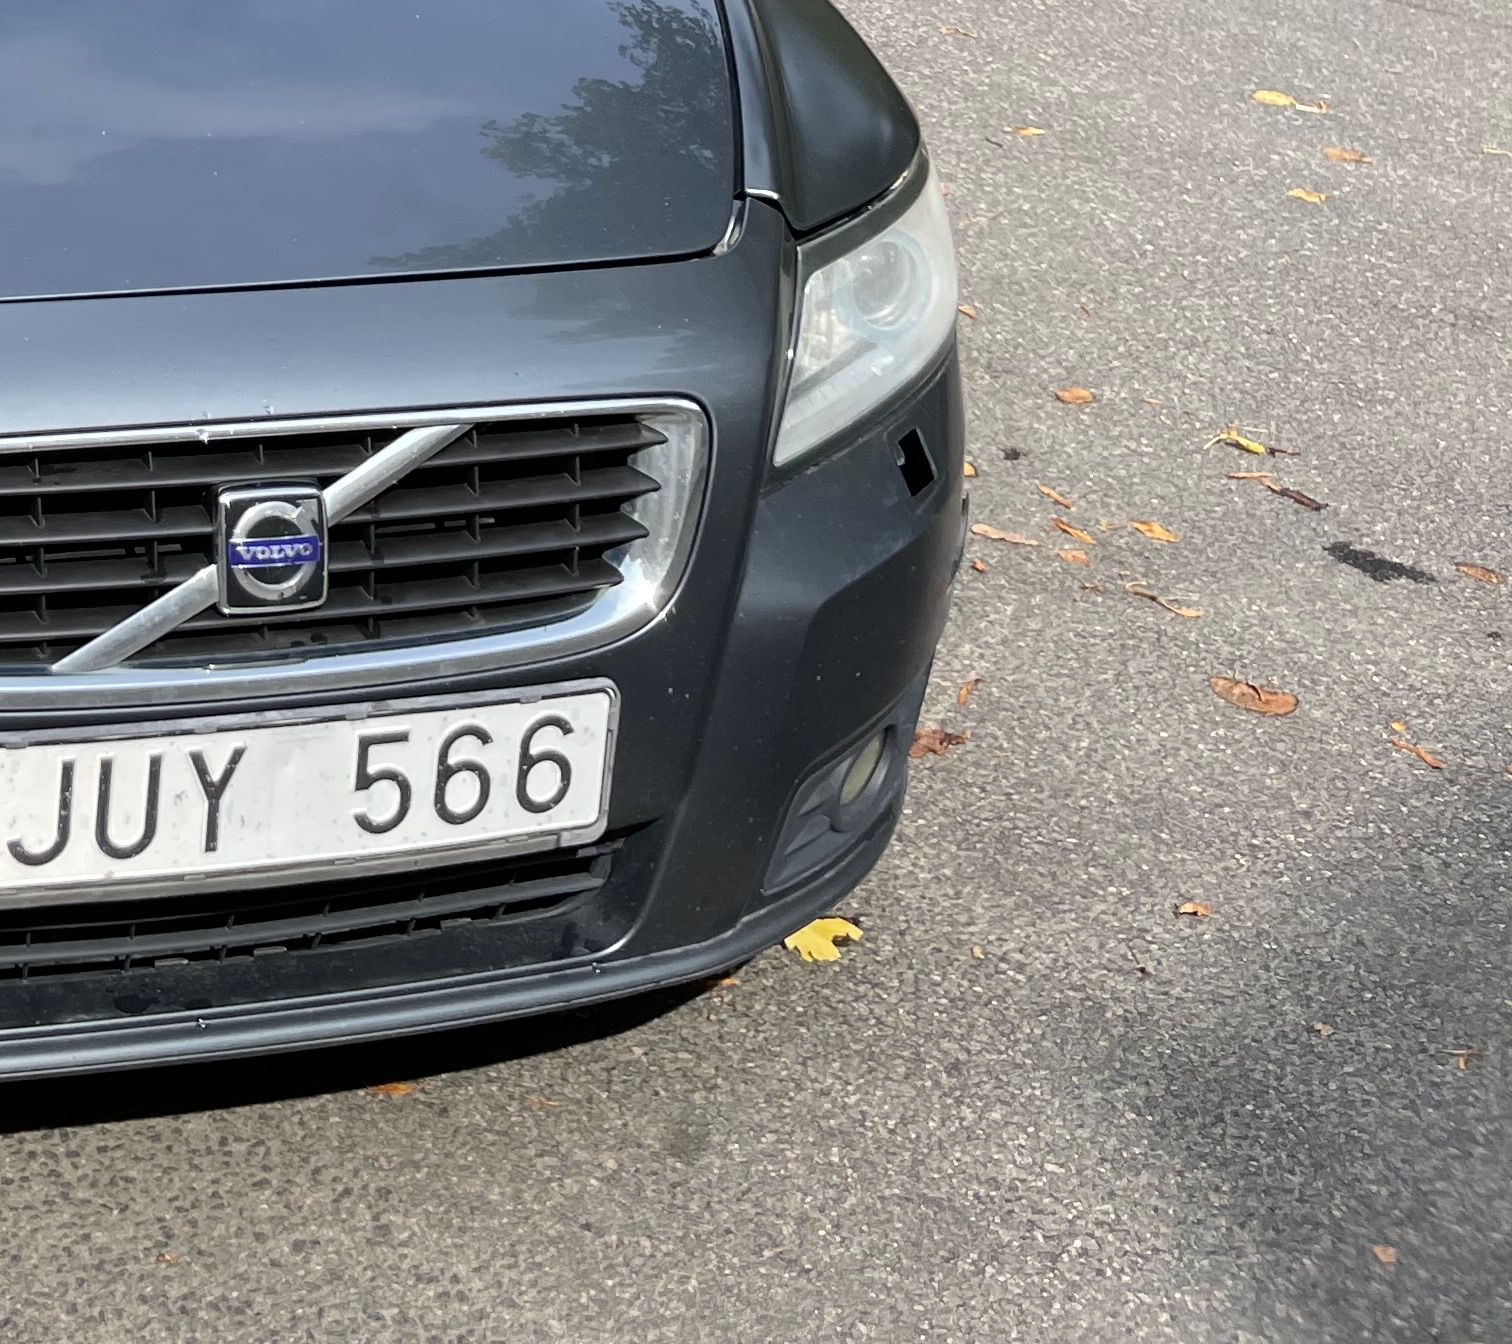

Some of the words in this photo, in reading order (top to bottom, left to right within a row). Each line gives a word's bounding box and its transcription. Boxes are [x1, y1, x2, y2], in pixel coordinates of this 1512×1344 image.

[235, 543, 313, 560] VOLVO
[6, 745, 248, 867] JUY
[353, 712, 576, 834] 566
